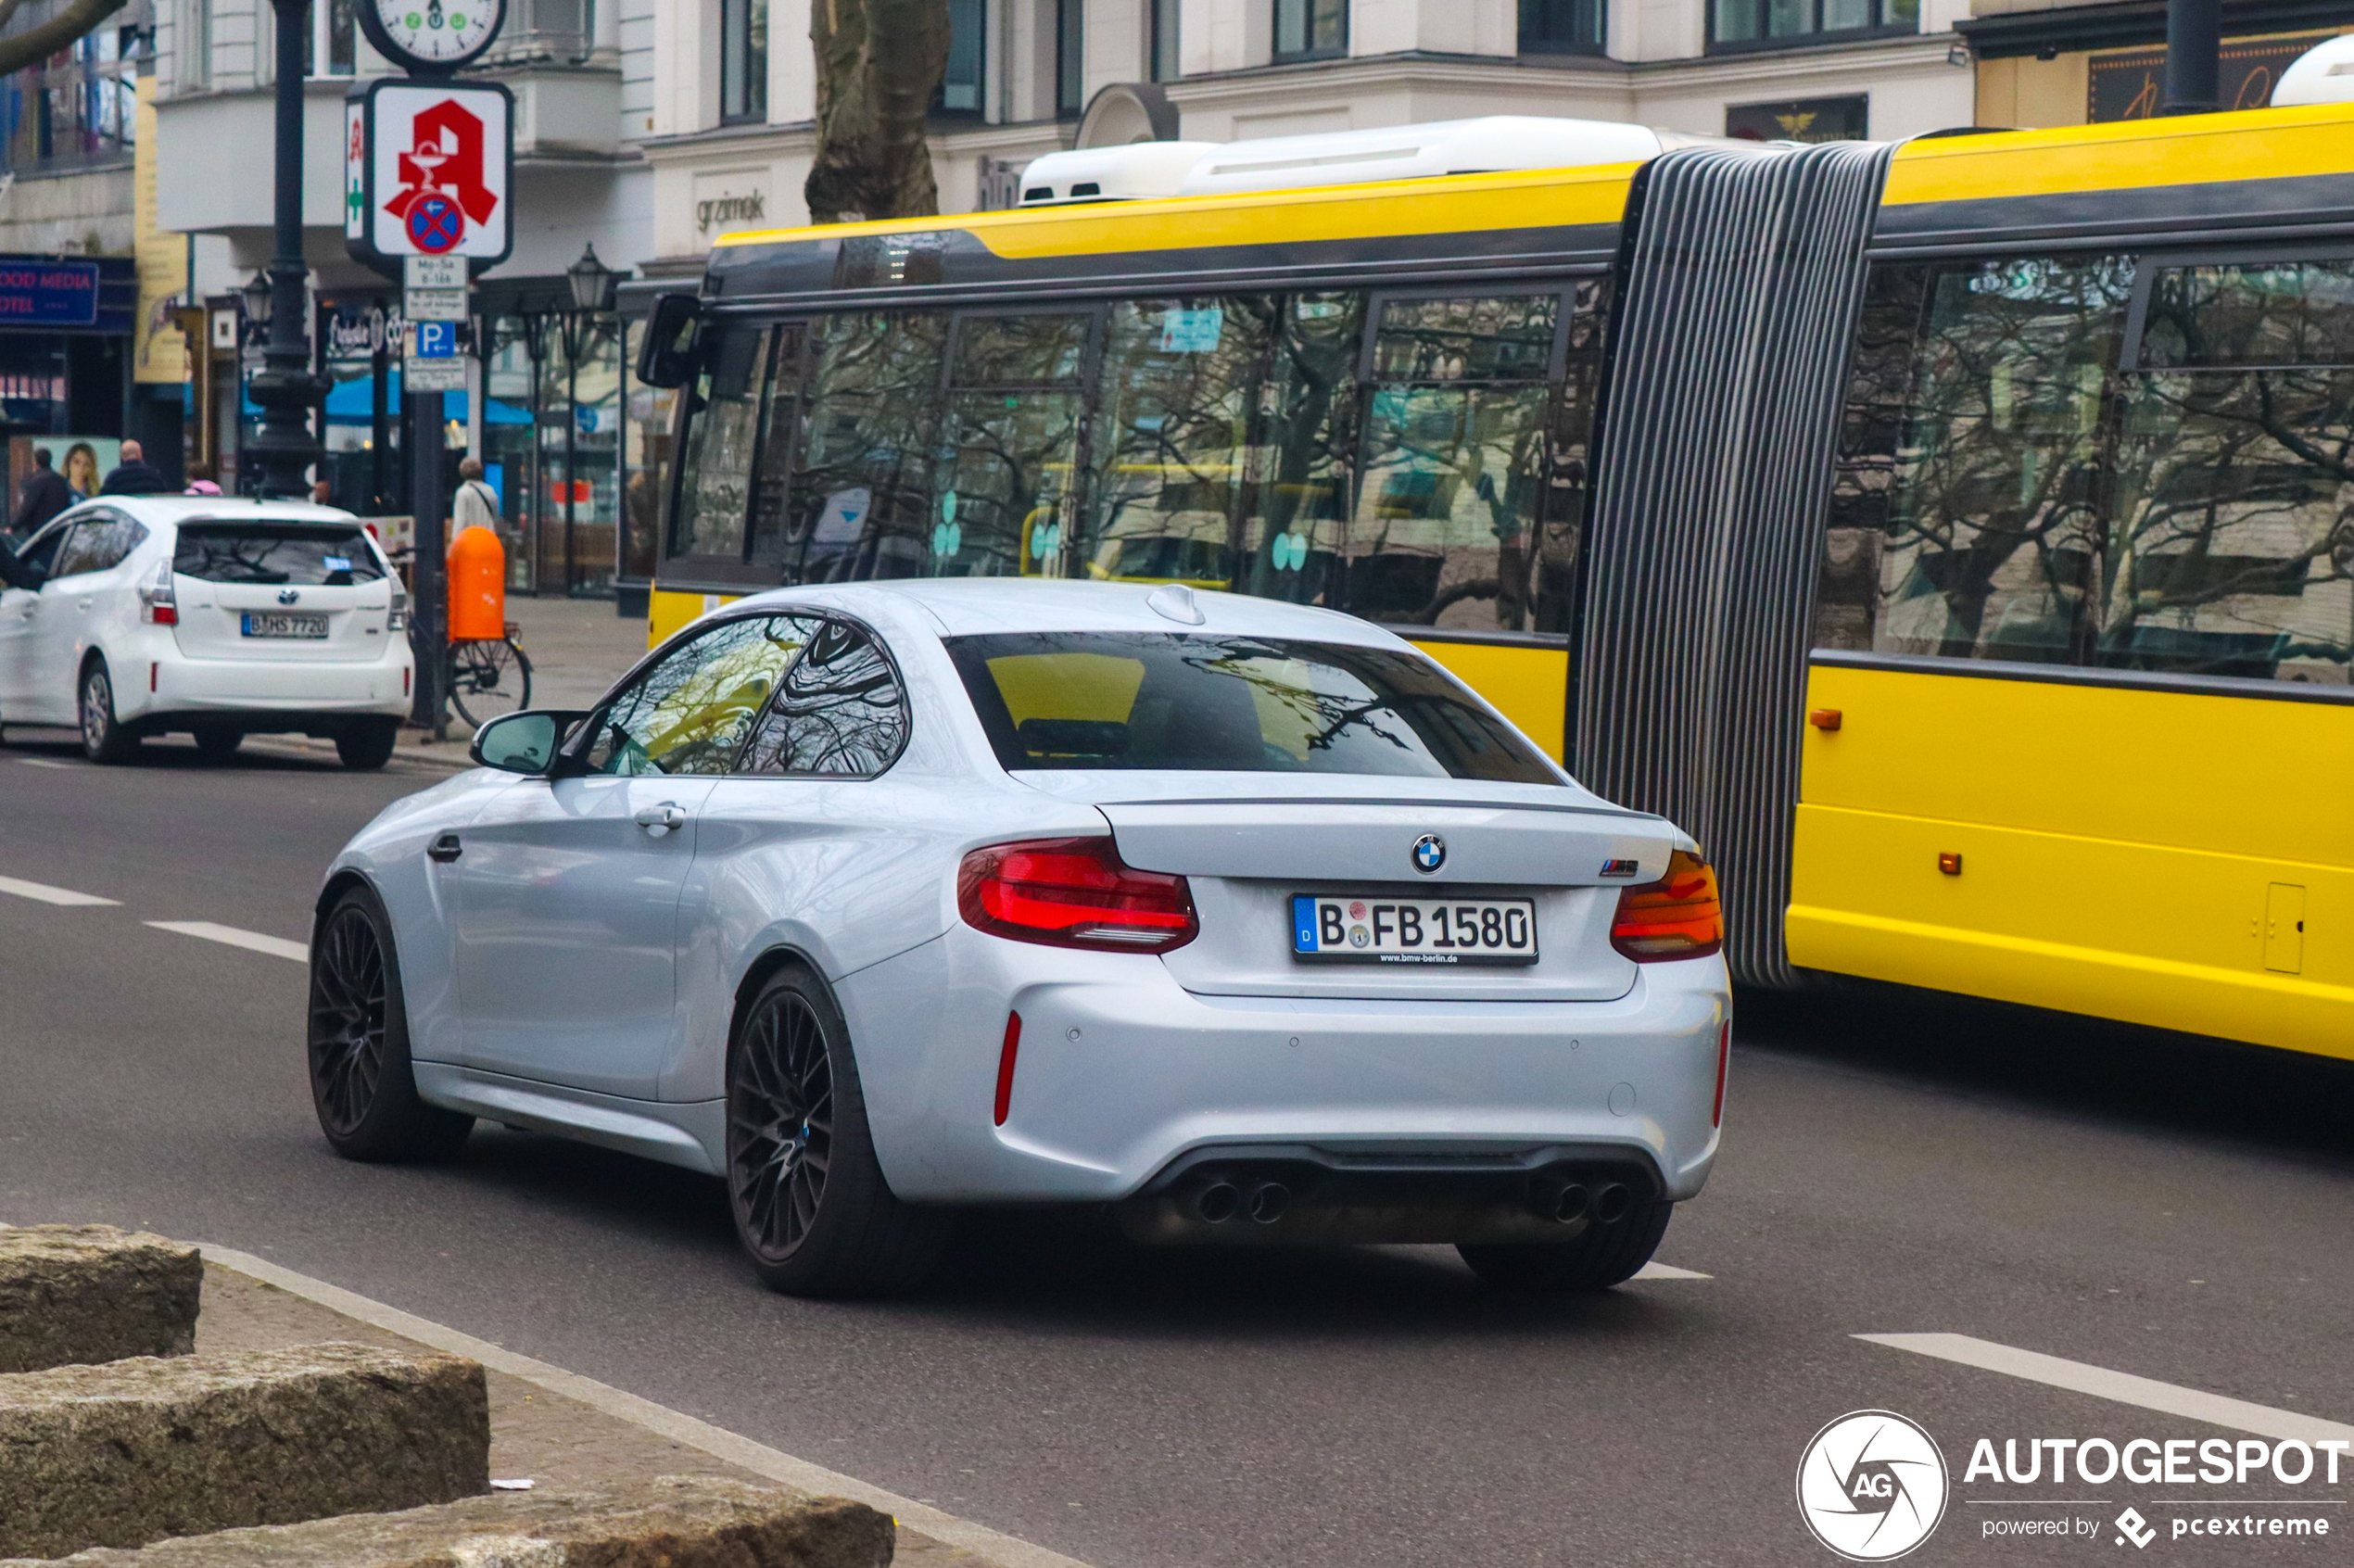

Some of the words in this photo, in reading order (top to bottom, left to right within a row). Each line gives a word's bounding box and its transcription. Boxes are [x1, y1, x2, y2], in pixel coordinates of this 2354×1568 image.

[697, 188, 765, 233] grzimek
[41, 272, 91, 289] MEDIA
[424, 323, 443, 352] P
[251, 617, 259, 631] B
[270, 618, 288, 632] HS
[293, 619, 326, 633] 7720
[1417, 835, 1444, 848] BMW
[1301, 929, 1310, 942] D
[1320, 904, 1345, 945] B
[1373, 904, 1424, 947] FB
[1432, 906, 1528, 949] 1580
[1380, 953, 1458, 964] www.bmw-berlin.de
